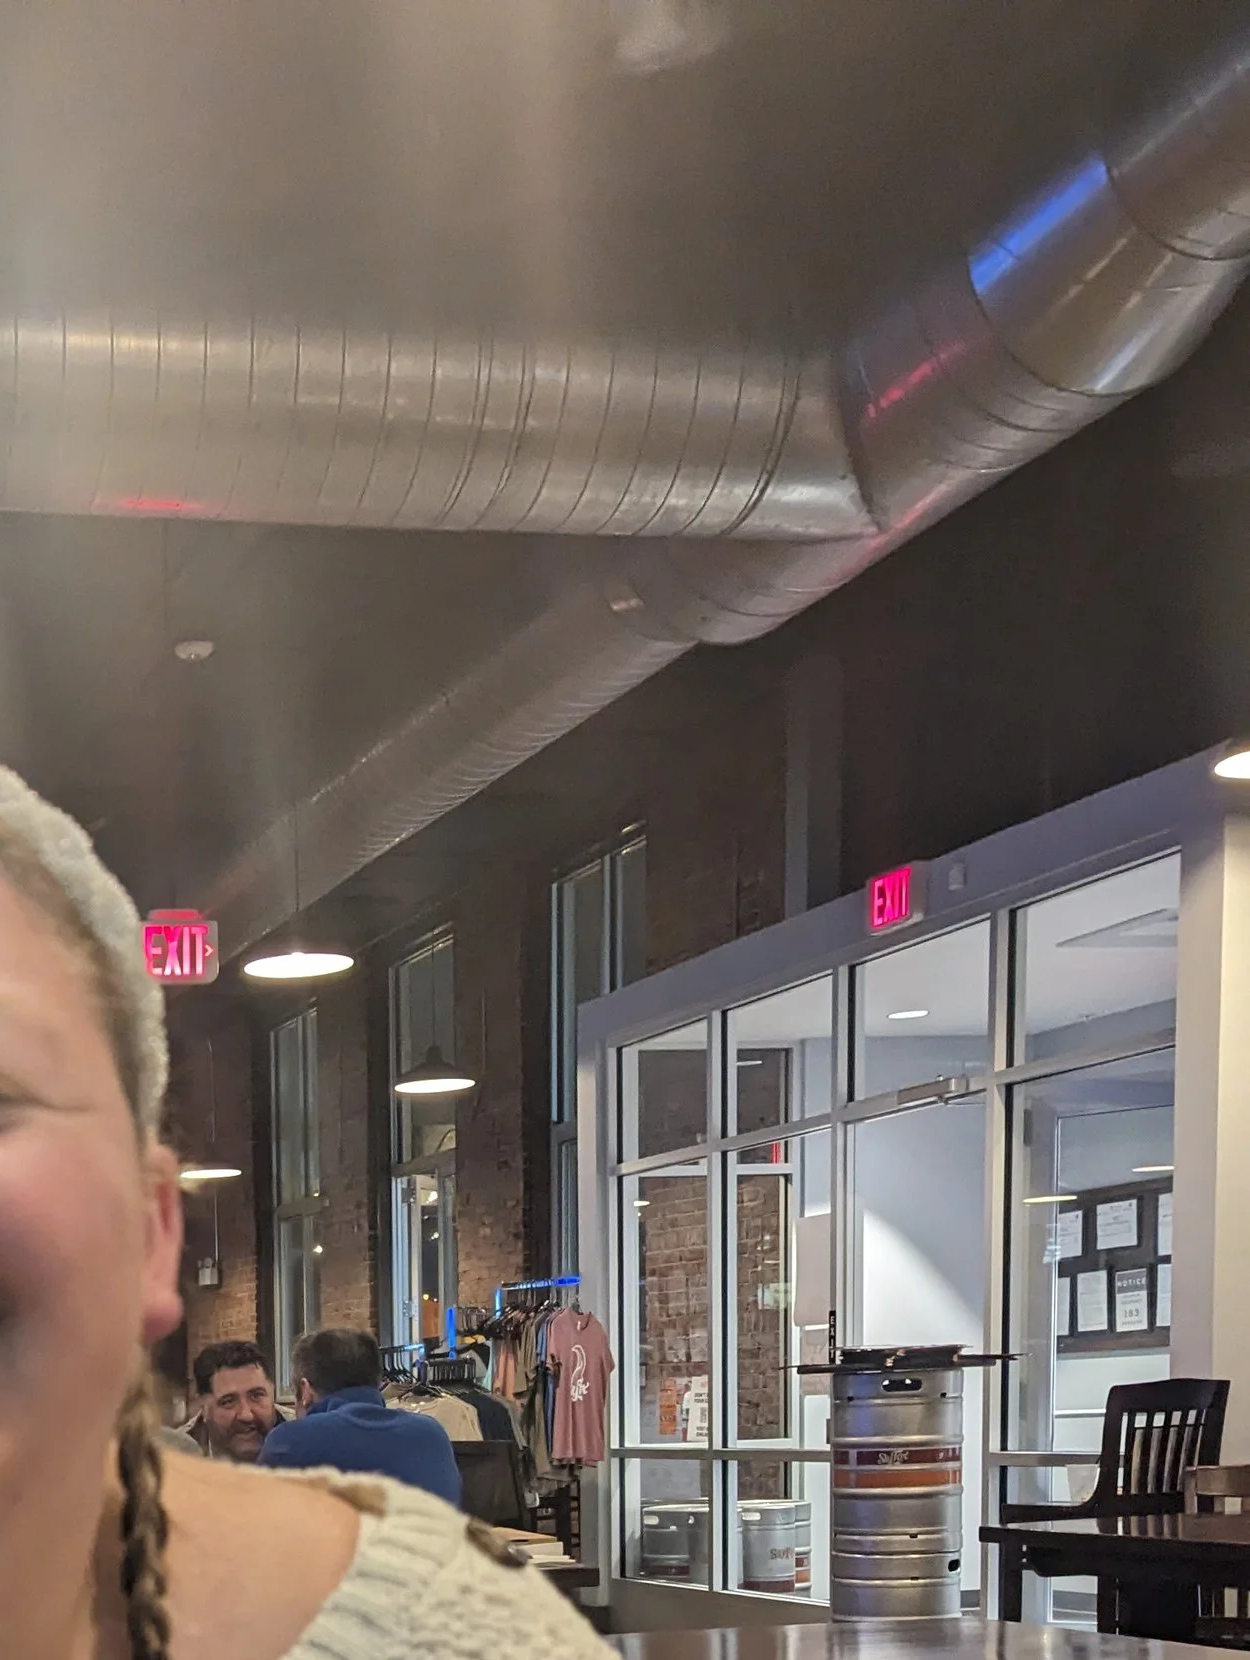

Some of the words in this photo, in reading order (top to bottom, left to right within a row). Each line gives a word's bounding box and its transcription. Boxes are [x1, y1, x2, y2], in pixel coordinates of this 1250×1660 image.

[873, 868, 911, 926] EXIT
[144, 926, 208, 976] EXIT
[1117, 1276, 1146, 1287] NOTICE
